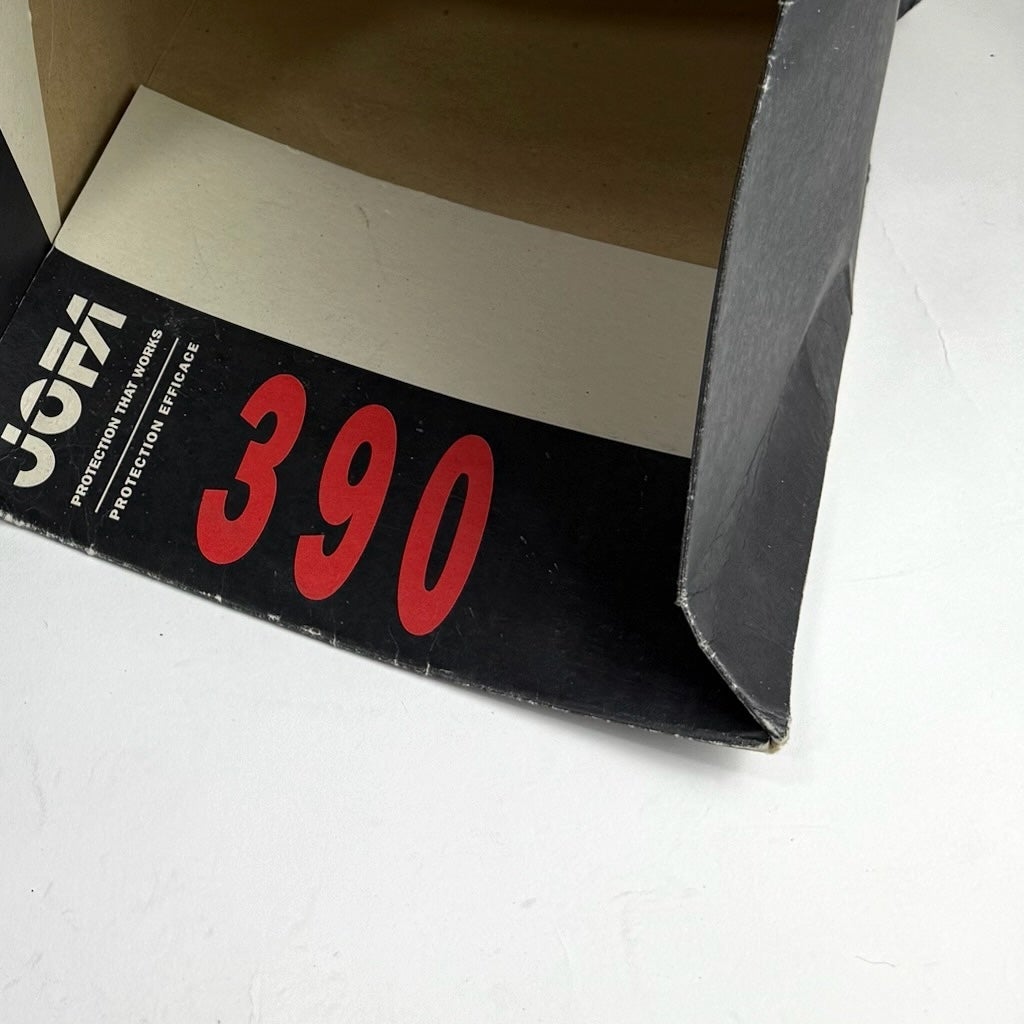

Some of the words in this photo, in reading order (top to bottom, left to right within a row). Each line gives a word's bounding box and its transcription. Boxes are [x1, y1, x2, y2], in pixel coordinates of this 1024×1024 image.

[0, 294, 127, 487] JOFA
[70, 416, 122, 508] PROTECTION
[114, 380, 138, 415] THAT
[131, 328, 163, 378] WORKS
[108, 419, 164, 521] PROTECTION
[158, 341, 200, 416] EFFICACE
[196, 374, 494, 636] 390
